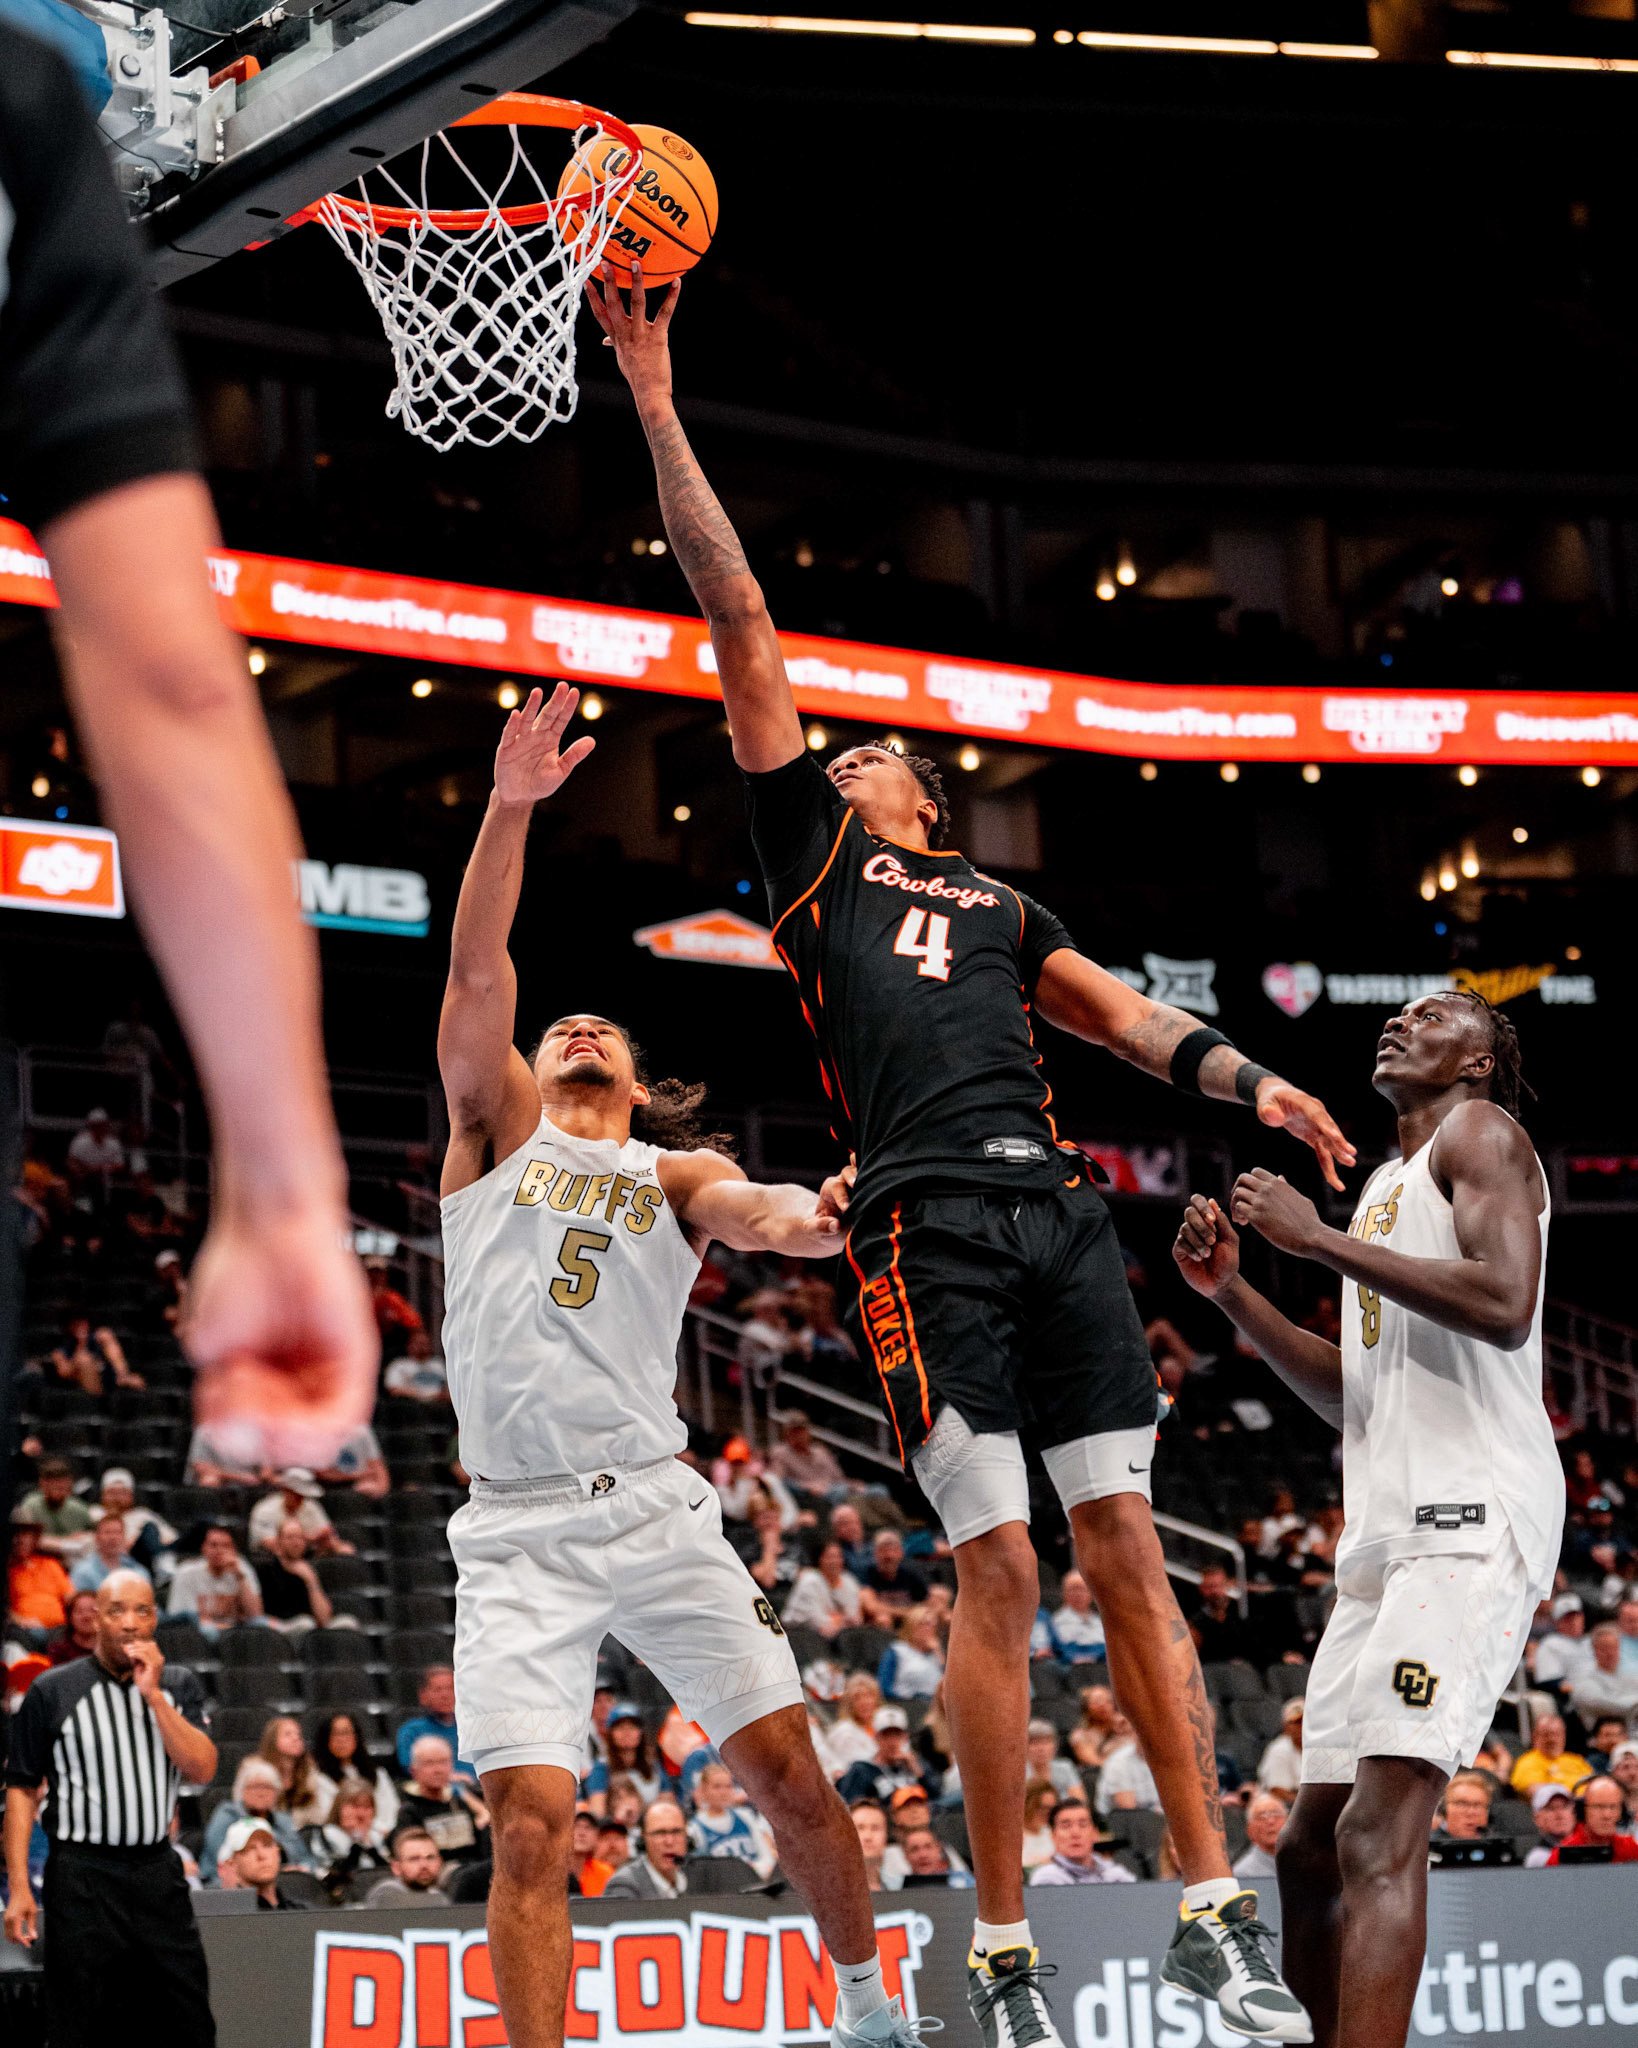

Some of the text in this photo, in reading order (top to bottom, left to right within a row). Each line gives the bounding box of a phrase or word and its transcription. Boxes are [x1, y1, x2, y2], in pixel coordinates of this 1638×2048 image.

[292, 860, 431, 922] MB
[863, 853, 1001, 909] Cowboys
[893, 905, 953, 982] 4
[513, 1159, 664, 1235] BUFFS
[549, 1227, 612, 1310] 5
[864, 1275, 908, 1374] POKES
[1464, 1507, 1477, 1518] 48
